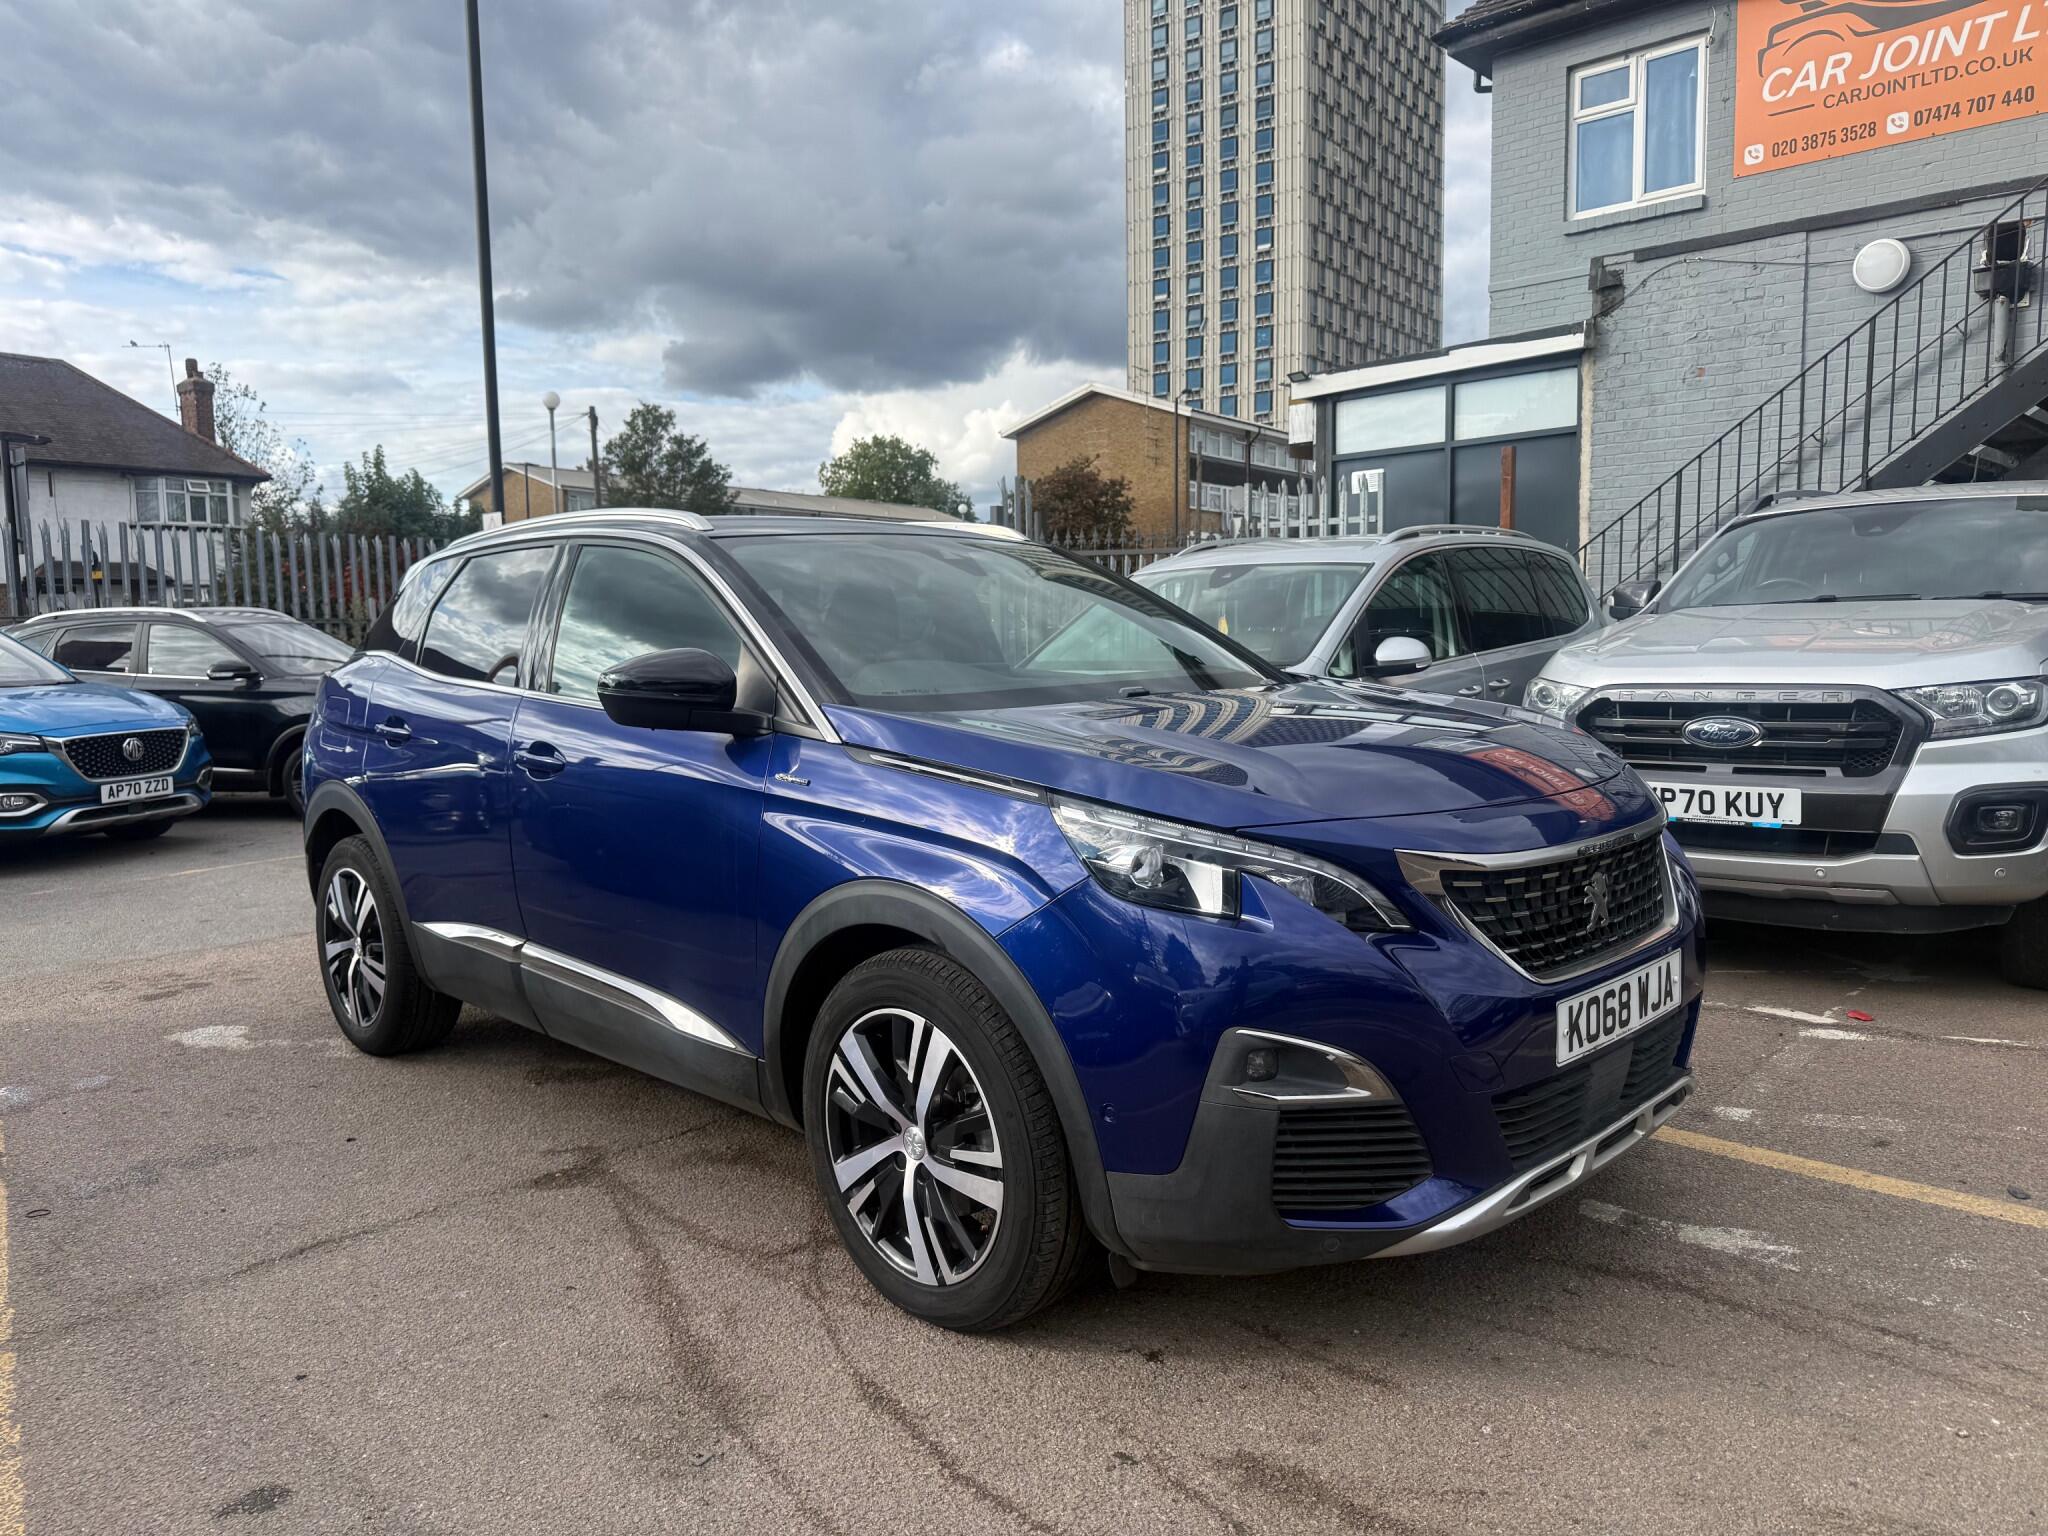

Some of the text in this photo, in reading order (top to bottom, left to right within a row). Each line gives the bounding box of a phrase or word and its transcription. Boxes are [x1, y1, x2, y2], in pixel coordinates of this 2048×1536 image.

[1762, 0, 2048, 103] CAR JOINT L
[1823, 46, 2034, 109] CARJOINTLTD.CO.UK
[1914, 85, 2035, 127] 07474 707 440
[1772, 121, 1877, 158] 020 3875 3528
[1618, 690, 1844, 702] RANGER
[1699, 722, 1741, 741] Ford
[108, 778, 169, 799] AP70 ZZD
[1653, 788, 1785, 819] P70 KUY
[1568, 982, 1631, 1053] KO68
[1637, 961, 1673, 1020] WJA
